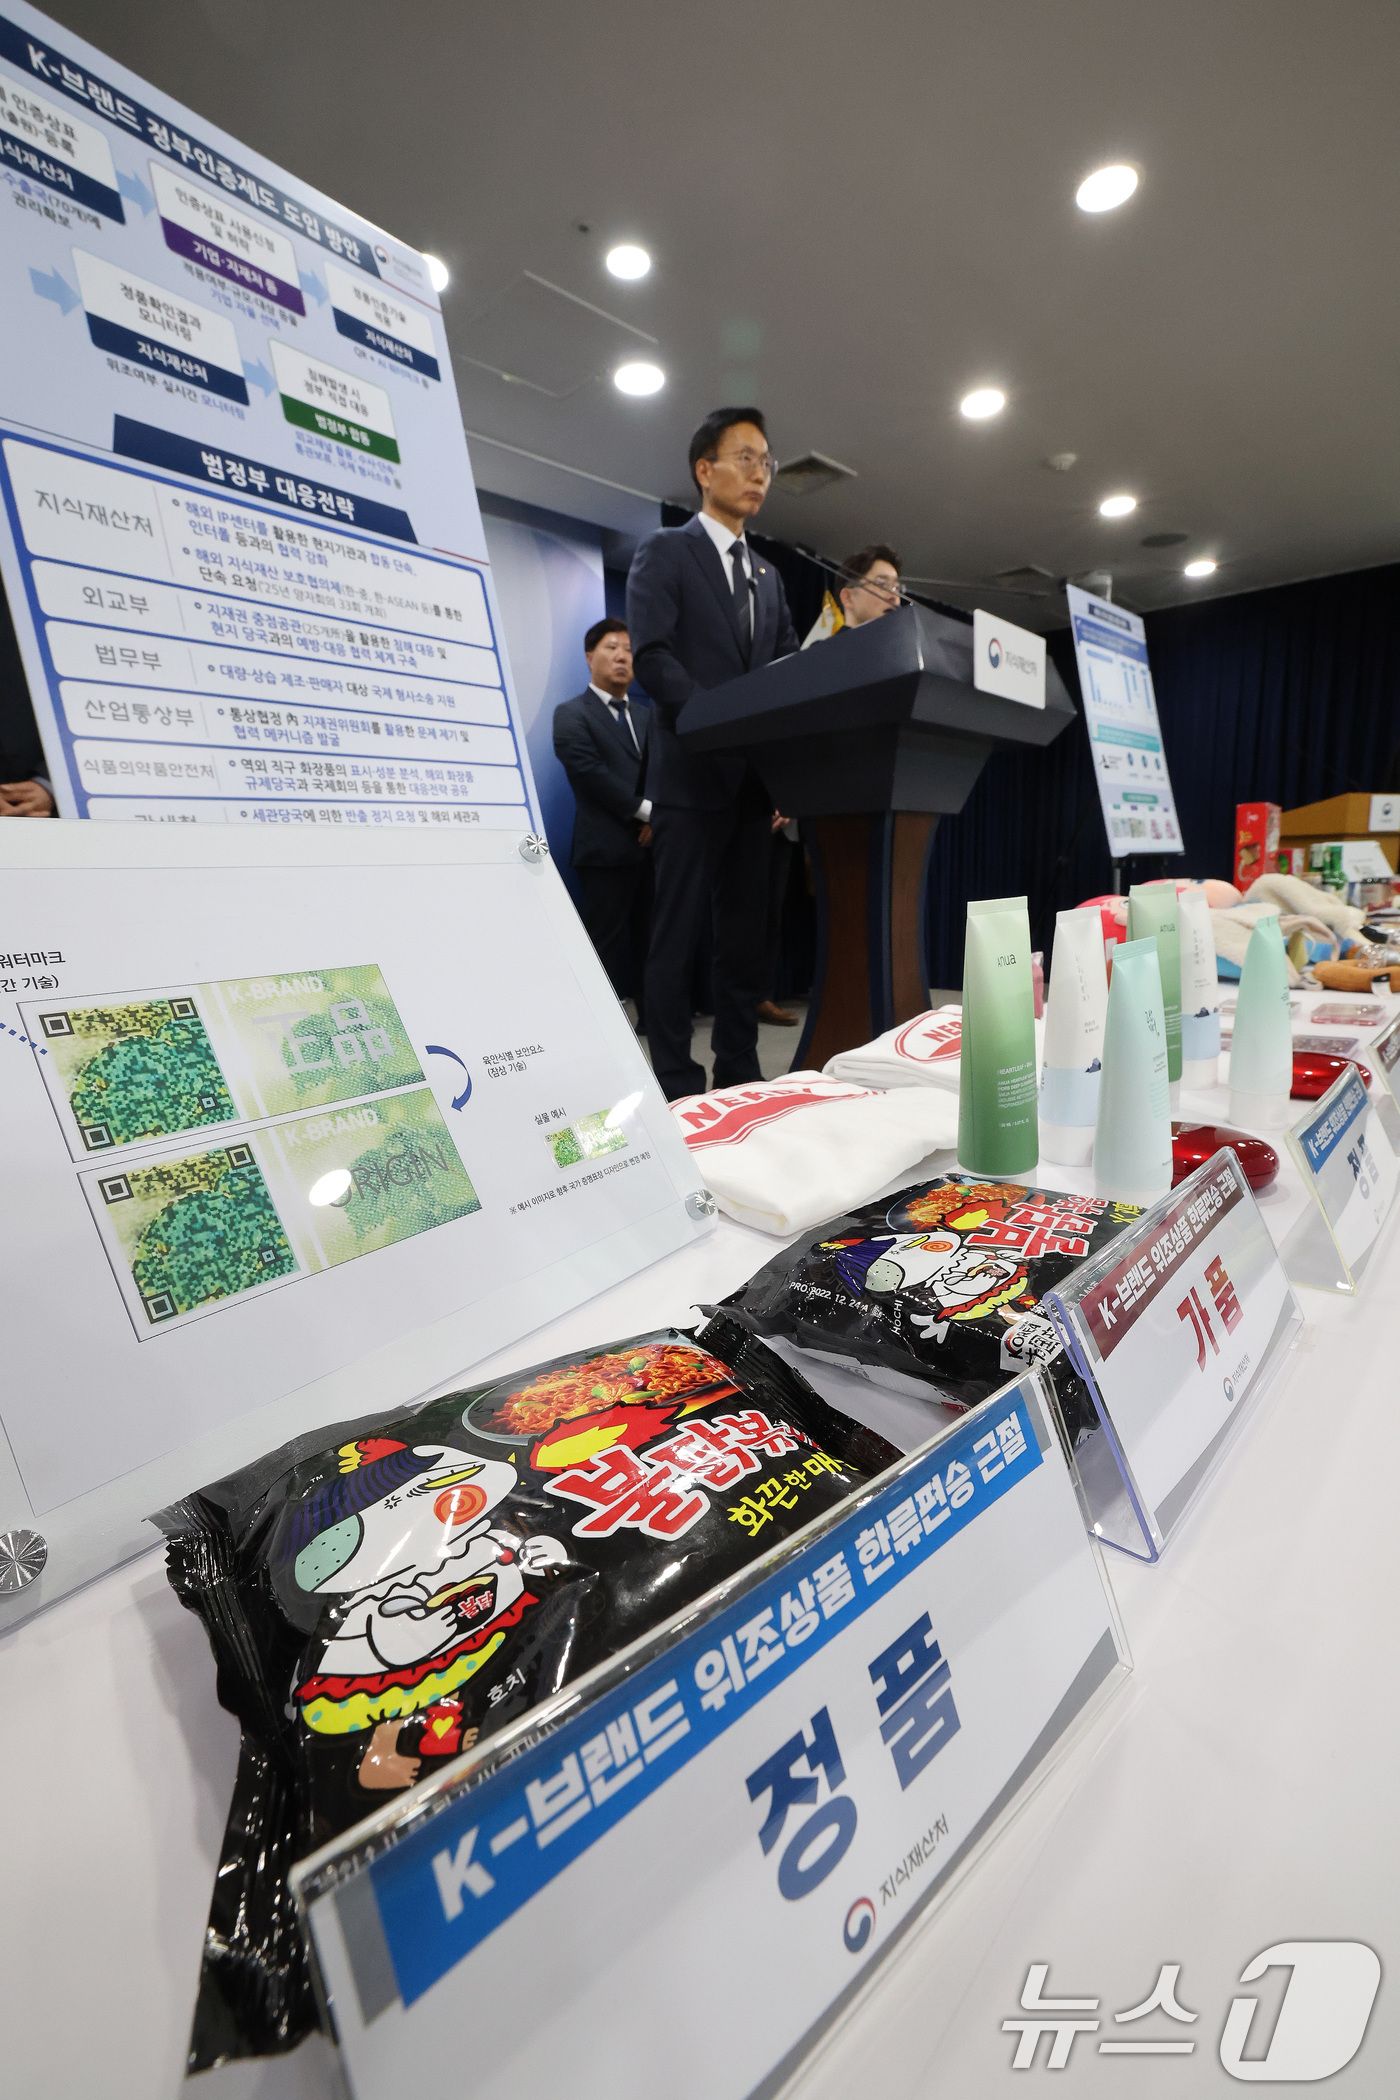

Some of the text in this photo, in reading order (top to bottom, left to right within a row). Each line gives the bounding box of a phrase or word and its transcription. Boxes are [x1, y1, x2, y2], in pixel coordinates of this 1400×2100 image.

[0, 136, 74, 192] 식재산처
[27, 42, 361, 264] K-브랜드 정부인증제도 도입 방안
[138, 306, 193, 342] 모니터링
[136, 340, 209, 384] 지식재산처
[201, 450, 356, 521] 범정부 대응전략
[34, 489, 155, 538] 지식재산처
[184, 501, 214, 523] 해외
[217, 510, 269, 538] IP센터를
[194, 547, 224, 568] 해외
[227, 556, 279, 582] 지식재산
[199, 566, 228, 586] 단속
[82, 585, 150, 616] 외교부
[206, 603, 249, 625] 지재권
[210, 619, 240, 640] 현지
[241, 625, 294, 649] 당국과의
[95, 643, 163, 671] 법무부
[84, 698, 195, 728] 산업통상부
[229, 706, 282, 727] 통상협정
[232, 724, 261, 742] 협력
[83, 758, 217, 780] 식품의약품안전처
[240, 758, 268, 774] 역외
[299, 762, 348, 778] 화장품의
[244, 775, 310, 793] 규제당국과
[311, 778, 359, 794] 국제회의
[252, 808, 317, 824] 세관당국에
[318, 809, 343, 824] 의한
[0, 950, 67, 970] 워터마크
[0, 973, 60, 993] 간 기술)
[228, 974, 326, 1004] K-BRAND
[509, 1060, 527, 1075] 기술)
[515, 1044, 545, 1059] 보안요소
[283, 1107, 380, 1148] K-BRAND
[534, 1106, 567, 1126] 실물 예시
[1097, 1166, 1239, 1331] K-브랜드 위조상품 한류편승 근절
[891, 1299, 904, 1335] HOCHI
[1176, 1254, 1245, 1373] 가품
[1008, 1322, 1042, 1360] KOREA
[727, 1469, 812, 1537] 화끈한
[431, 1677, 692, 1923] K-브랜드
[693, 1550, 858, 1712] 위조상품
[852, 1461, 976, 1587] 한류편승
[972, 1410, 1028, 1485] 근절
[487, 1667, 527, 1708] 호치
[745, 1610, 963, 1903] 정품
[877, 1812, 951, 1906] 지식재산처
